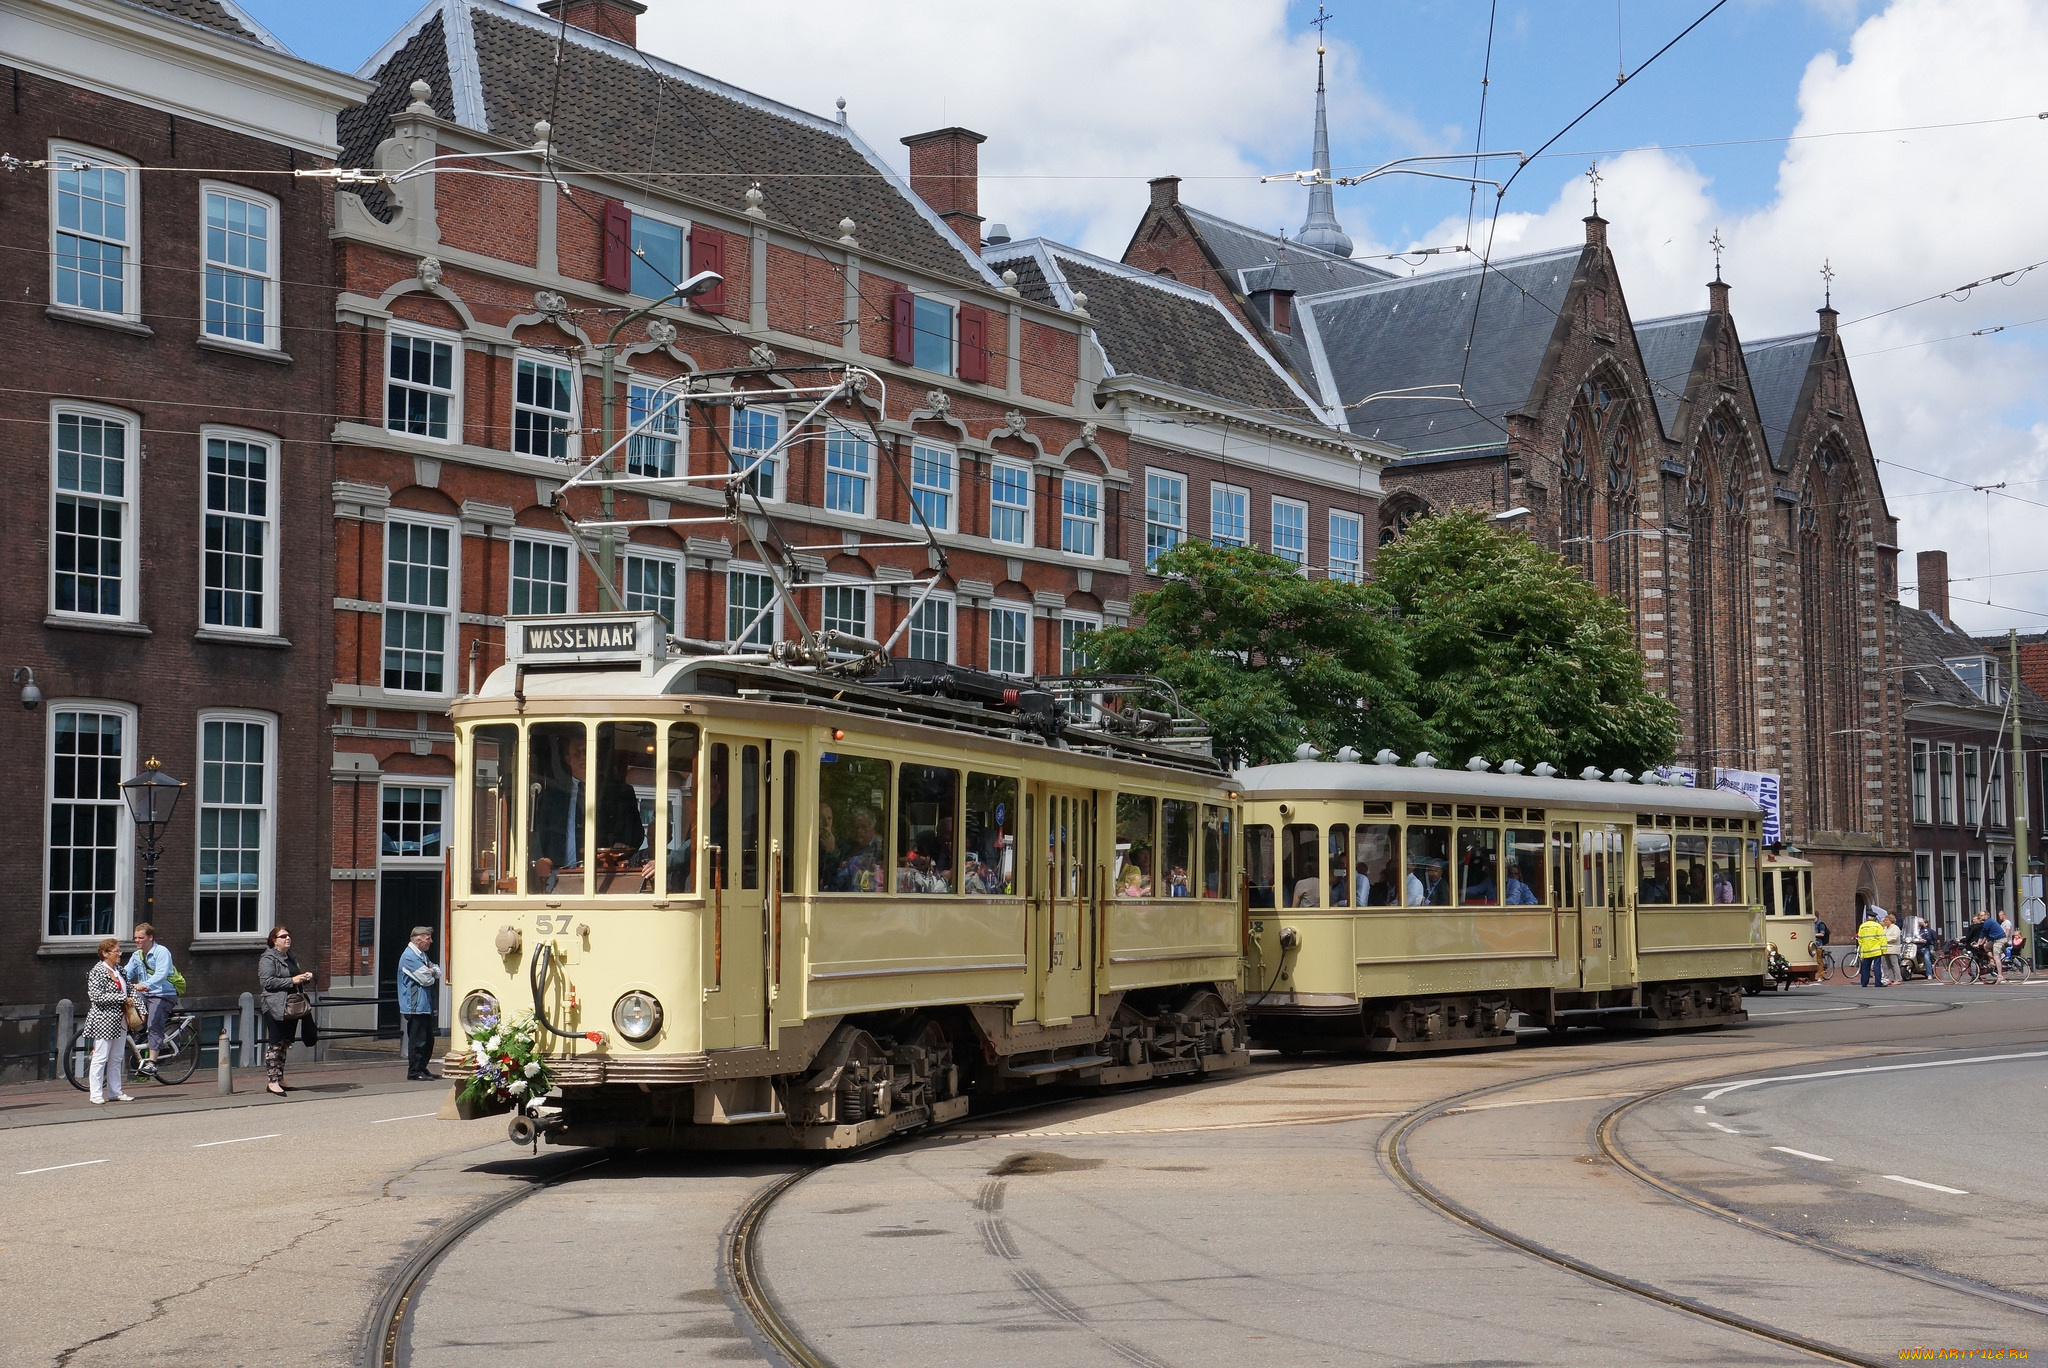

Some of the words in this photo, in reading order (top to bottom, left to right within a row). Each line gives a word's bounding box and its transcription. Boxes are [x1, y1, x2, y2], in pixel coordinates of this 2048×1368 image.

[529, 626, 634, 649] WASSENAAR
[535, 914, 574, 935] 57
[1790, 932, 1797, 940] 2
[1053, 950, 1064, 966] 57
